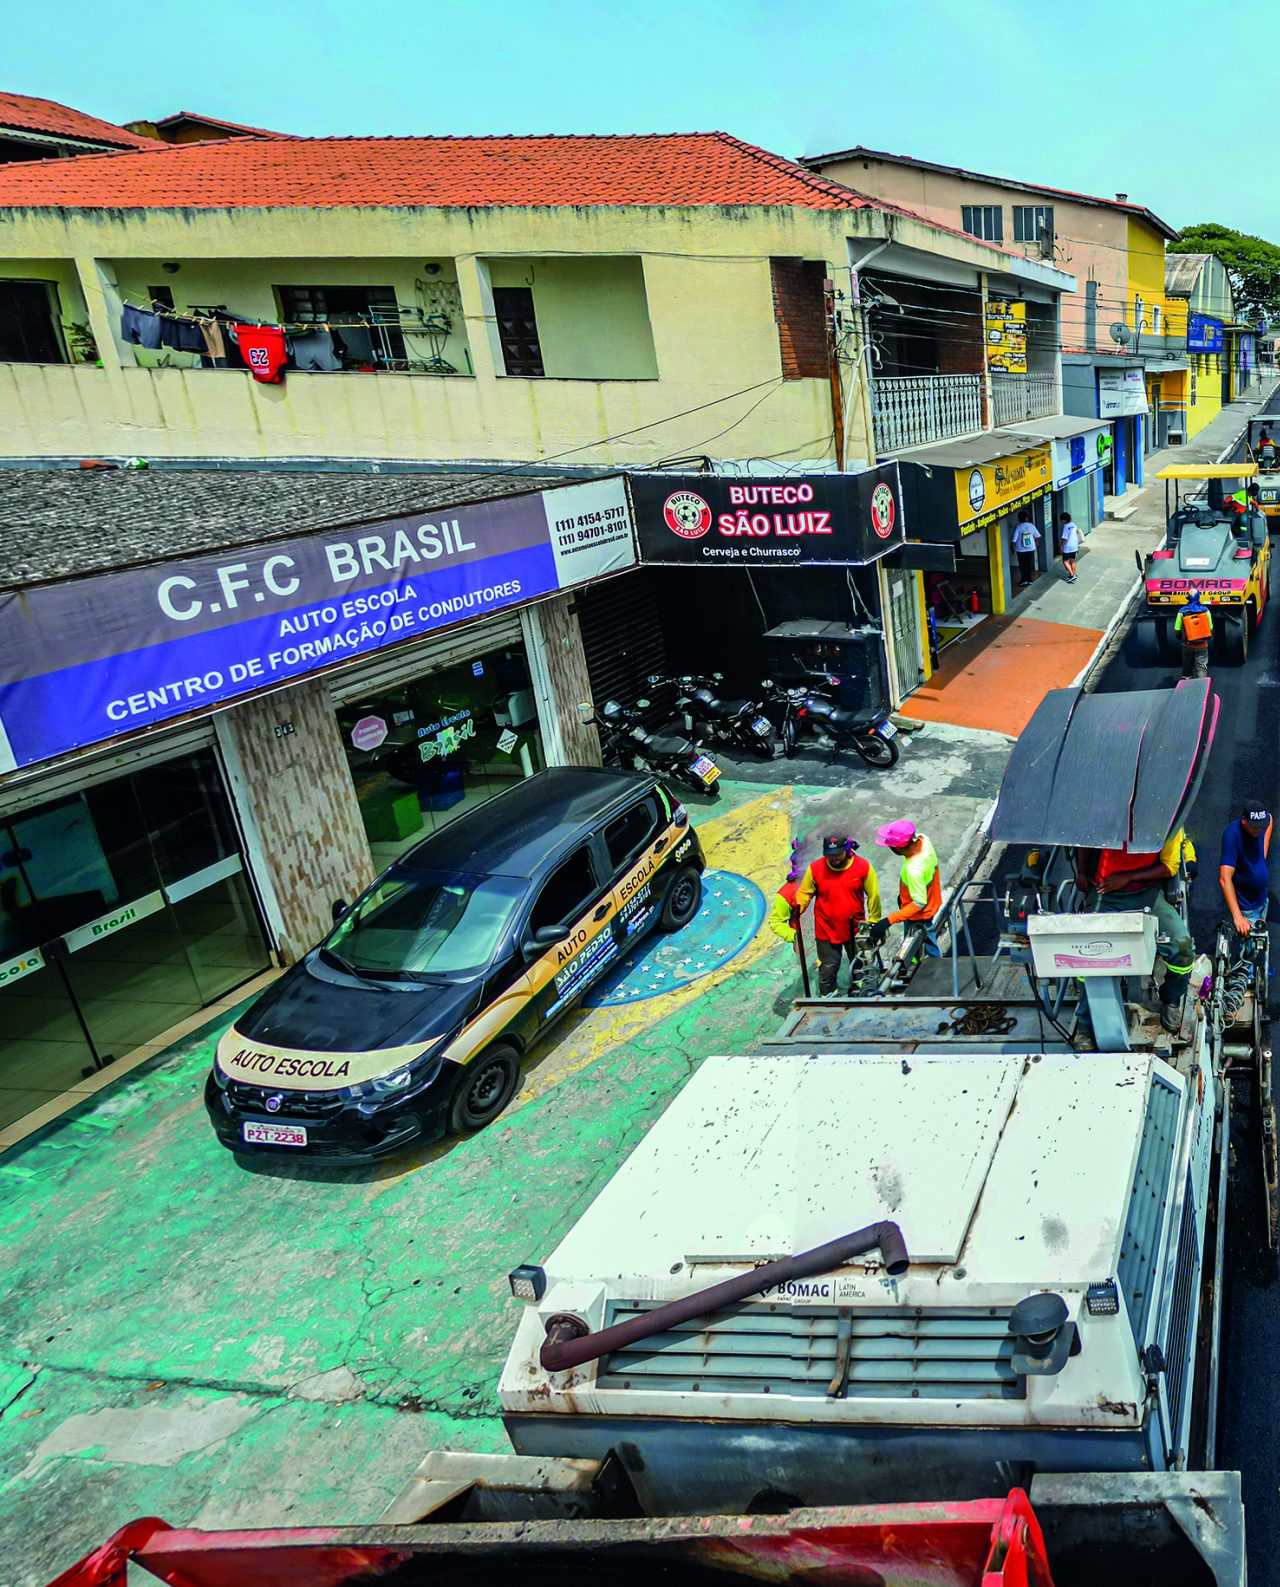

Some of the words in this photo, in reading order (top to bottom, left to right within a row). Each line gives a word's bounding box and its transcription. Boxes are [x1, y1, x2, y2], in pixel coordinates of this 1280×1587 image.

[670, 494, 700, 505] BUTECO
[729, 482, 814, 505] BUTECO
[1261, 490, 1278, 500] CAT
[555, 518, 575, 532] (11)
[577, 506, 624, 526] 4154-5717
[719, 509, 770, 536] SÃO
[773, 511, 832, 535] LUIZ
[558, 533, 575, 546] (11)
[577, 520, 628, 541] 94701-8101
[702, 547, 740, 558] Cerveja
[742, 549, 748, 557] e
[749, 546, 800, 557] Churrasco
[157, 554, 300, 621] C.F.C
[325, 519, 476, 583] BRASIL
[1160, 580, 1232, 589] BOMAG
[279, 606, 338, 637] AUTO
[343, 585, 417, 619] ESCOLA
[106, 669, 225, 722] CENTRO
[230, 657, 264, 682] DE
[268, 620, 387, 672] FORMAÇÃO
[390, 611, 415, 632] DE
[418, 579, 522, 622] CONDUTORES
[418, 722, 440, 738] Auto
[441, 709, 471, 728] Escola
[92, 908, 136, 936] Brasil
[556, 930, 587, 965] AUTO
[620, 861, 655, 900] ESCOLA
[580, 927, 612, 964] PEDRO
[230, 1049, 276, 1072] AUTO
[274, 1058, 350, 1078] ESCOLA
[778, 1280, 830, 1297] BOMAG
